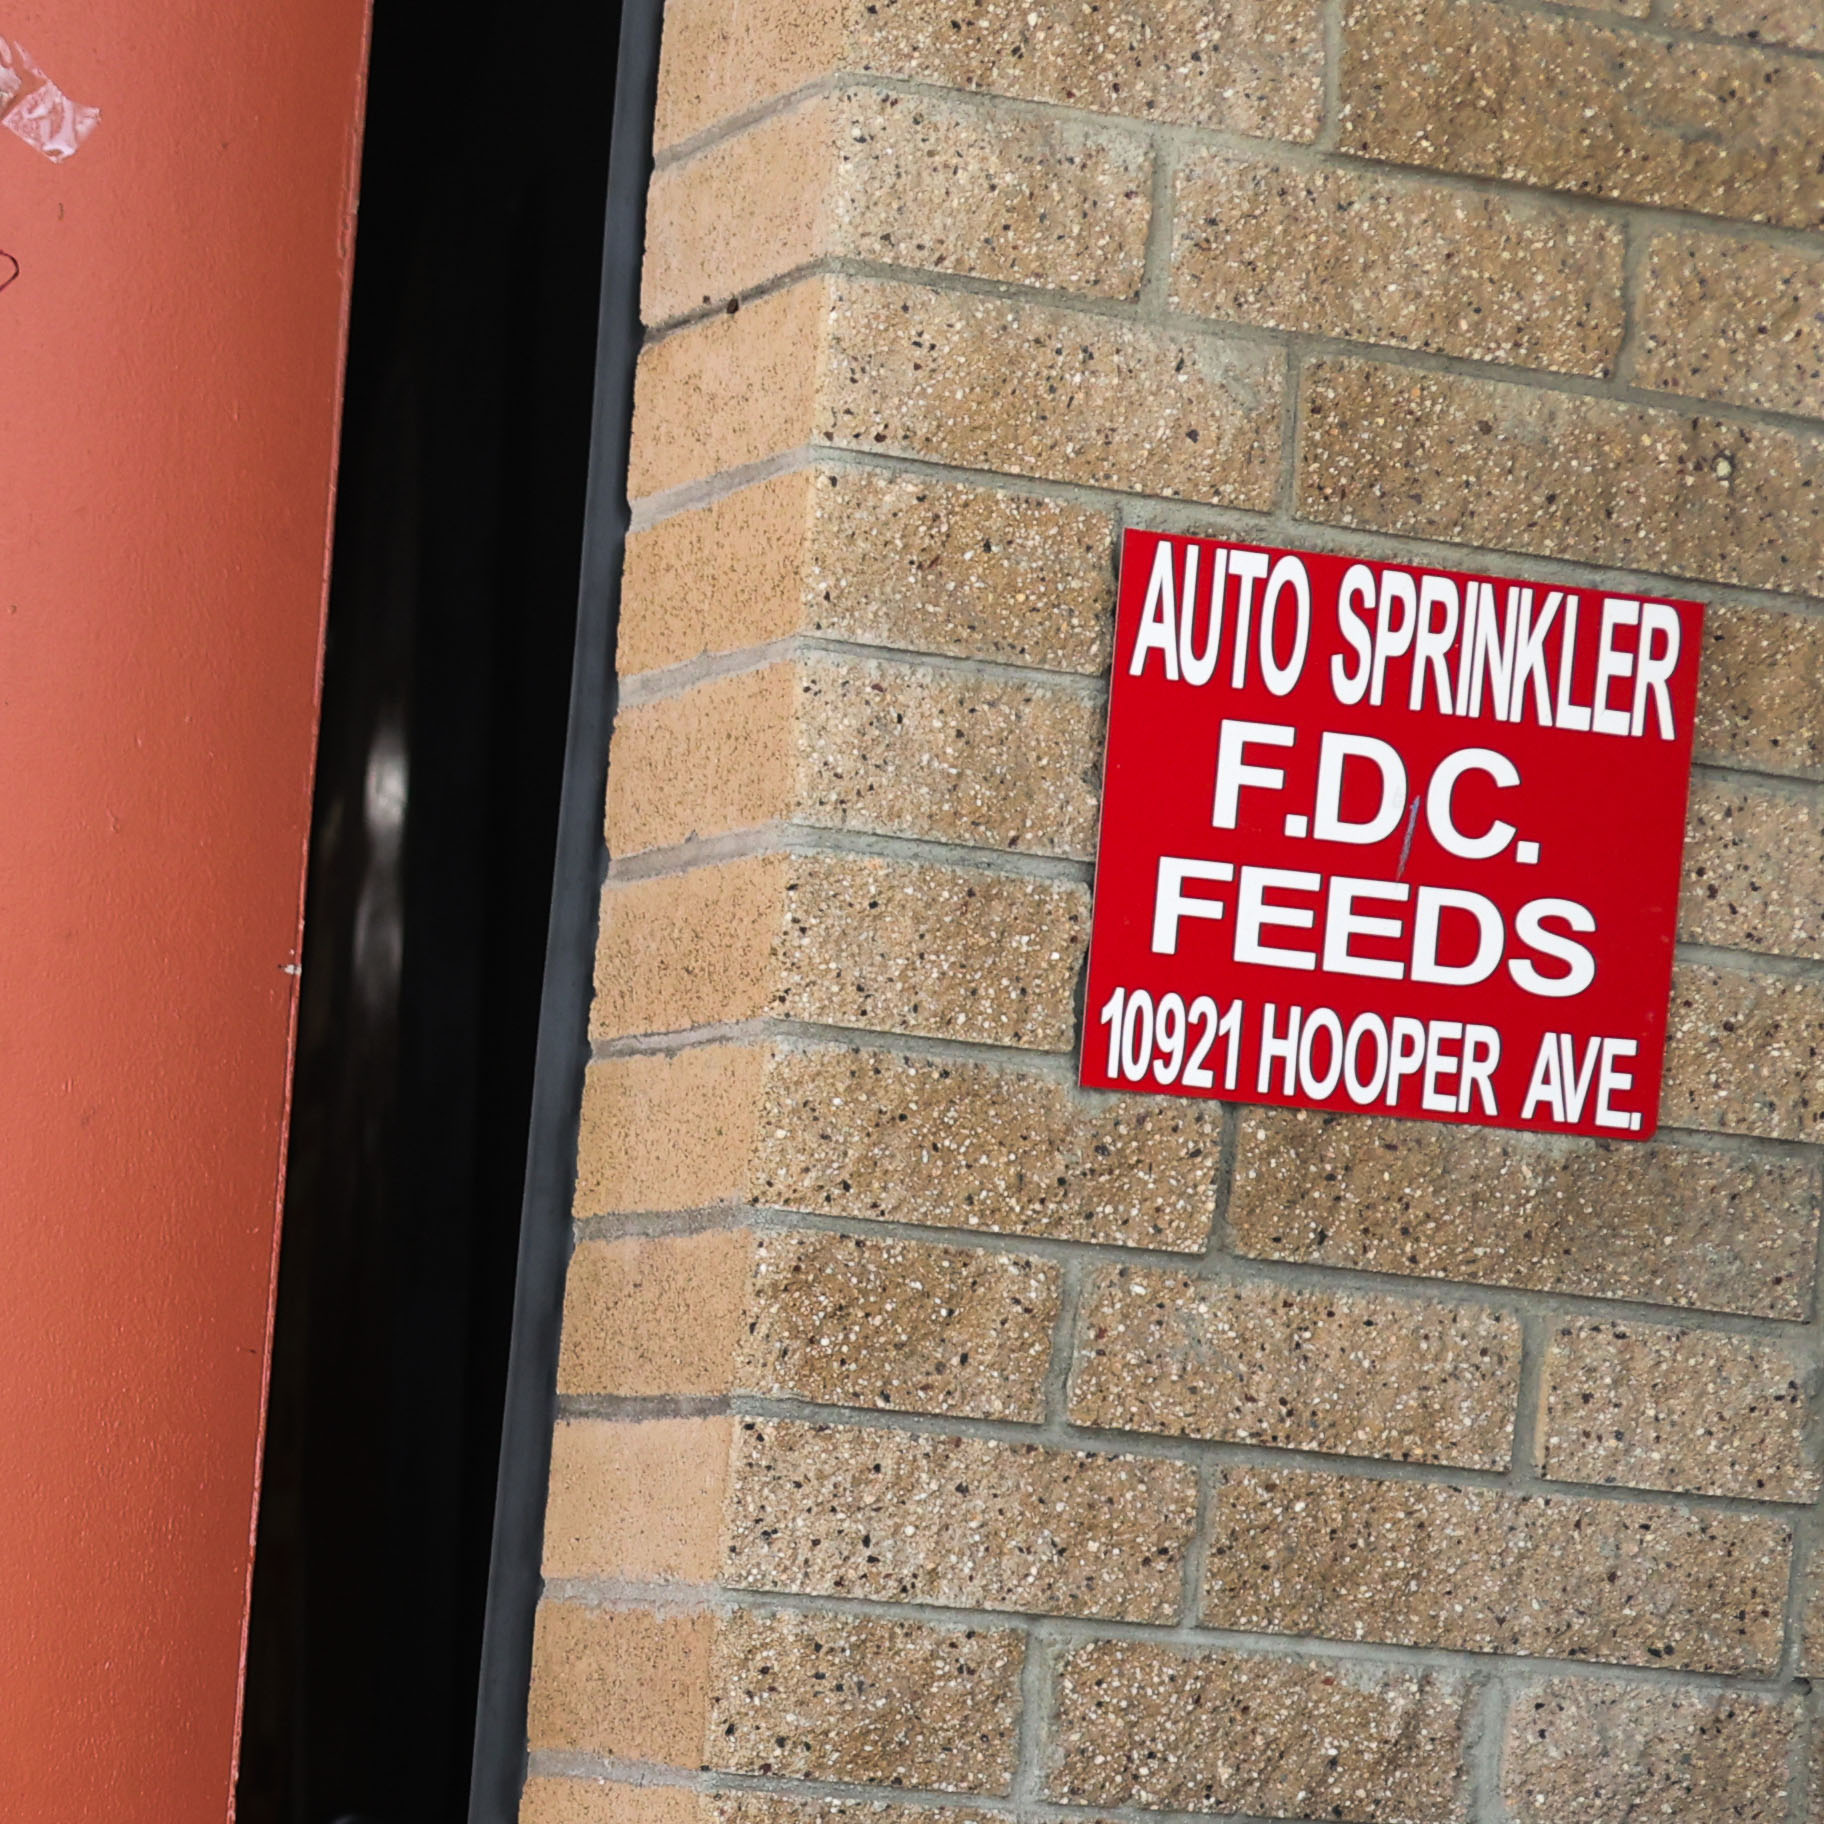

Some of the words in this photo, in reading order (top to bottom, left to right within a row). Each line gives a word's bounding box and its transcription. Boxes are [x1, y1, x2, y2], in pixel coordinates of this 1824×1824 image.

[1129, 540, 1311, 697] AUTO
[1331, 564, 1681, 740] SPRINKLER
[1152, 856, 1596, 997] FEEDS
[1100, 987, 1242, 1091] 10921
[1258, 1003, 1500, 1116] HOOPER
[1522, 1032, 1643, 1131] AVE.
